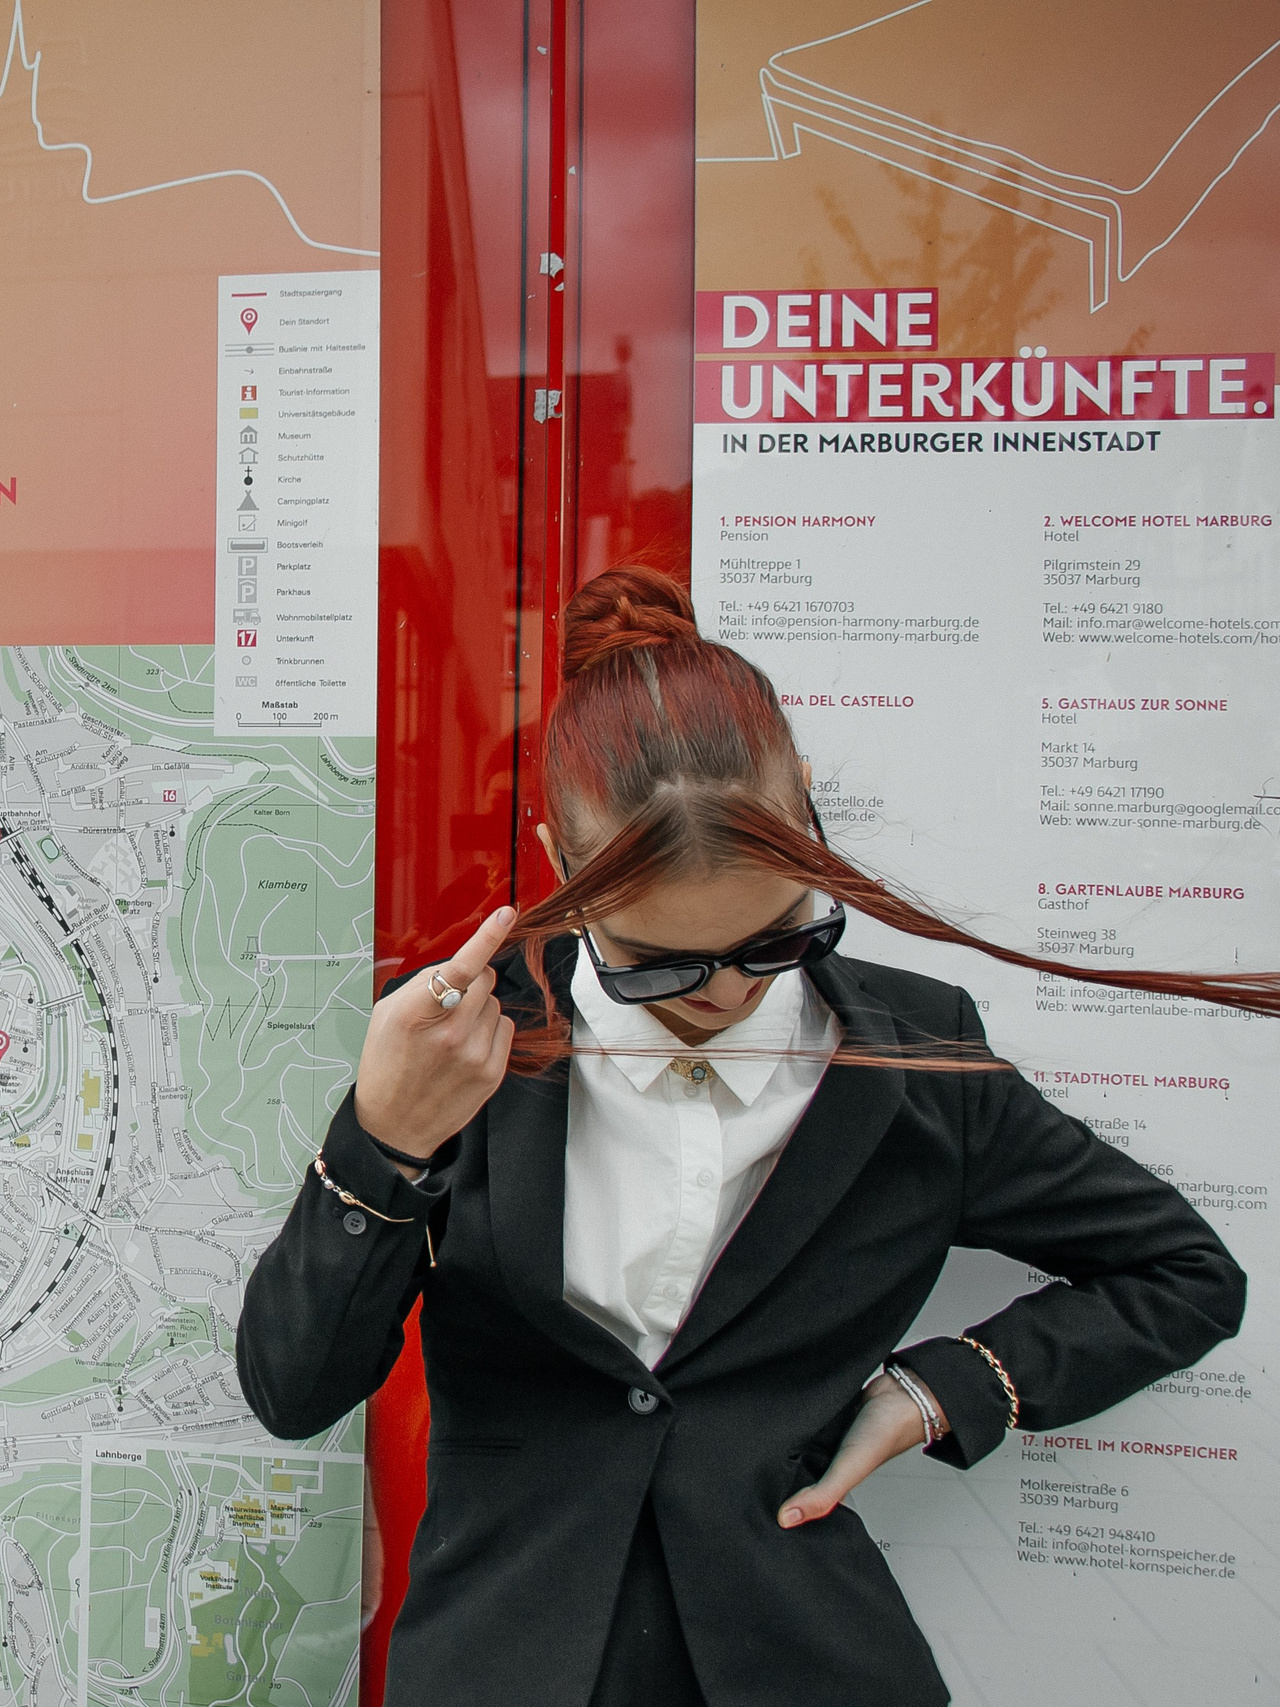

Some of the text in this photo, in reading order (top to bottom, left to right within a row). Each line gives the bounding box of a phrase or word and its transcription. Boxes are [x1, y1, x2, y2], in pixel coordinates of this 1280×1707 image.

[280, 289, 342, 297] Stadtspaziergang
[722, 293, 932, 348] DEINE
[722, 346, 1267, 419] UNTERKÜNFTE.
[279, 388, 350, 396] Tourist-Information
[278, 410, 355, 418] Universitätsgebäude
[723, 431, 1161, 453] IN DER MARBURGER INNENSTADT
[277, 497, 329, 506] Campingplatz
[277, 519, 307, 528] Minigolf
[720, 516, 875, 526] 1. PENSION HARMONY
[1044, 515, 1272, 526] 2. WELCOME HOTEL MARBURG
[721, 531, 768, 541] Pension
[1044, 531, 1079, 541] Hotel
[242, 558, 254, 574] P
[277, 563, 311, 571] Parkplatz
[720, 559, 801, 571] Mühltreppe 1
[1044, 560, 1140, 573] Pilgrimstein 29
[720, 573, 812, 586] 35037 Marburg
[1043, 574, 1140, 587] 35037 Marburg
[242, 588, 254, 601] P
[720, 601, 854, 612] Tel.: +49 6421 1670703
[1044, 603, 1163, 614] Tel.: +49 6421 9180
[276, 614, 352, 622] Wohnmobilstellplatz
[720, 616, 979, 630] Mail: info@pension-harmony-marburg.de
[1043, 618, 1072, 628] Mail:
[239, 631, 255, 645] 17
[719, 630, 979, 644] Web: www.pension-harmony-marburg.de
[1043, 632, 1280, 645] Web: www.welcome-hotels.com/ho
[810, 695, 835, 706] DEL
[841, 696, 914, 707] CASTELLO
[1042, 699, 1227, 711] 5. GASTHAUS ZUR SONNE
[1042, 713, 1076, 724] Hotel
[1042, 742, 1095, 753] Markt 14
[1041, 757, 1138, 771] 35037 Marburg
[164, 791, 175, 801] 16
[1041, 786, 1164, 798] Tel.: +49 6421 17190
[1040, 801, 1070, 811] Mail:
[1040, 815, 1261, 832] Web: www.zur-sonne-marburg.de
[258, 880, 307, 892] Klamberg
[1038, 884, 1244, 899] 8. GARTENLAUBE MARBURG
[1038, 899, 1089, 910] Gasthof
[1037, 928, 1116, 942] Steinweg 38
[1037, 942, 1134, 957] 35037 Marburg
[1037, 986, 1065, 997] Mail:
[1036, 1001, 1067, 1011] Web:
[267, 1022, 315, 1030] Spiegelslust
[1034, 1072, 1229, 1089] 11. STADTHOTEL MARBURG
[1134, 1120, 1146, 1130] 14
[56, 1168, 93, 1176] Anschluss
[1021, 1435, 1237, 1460] 17. HOTEL IM KORNSPEICHER
[96, 1450, 142, 1461] Lahnberge
[1021, 1450, 1057, 1463] Hotel
[1021, 1479, 1129, 1497] Molkereistraße 6
[1020, 1494, 1118, 1513] 35039 Marburg
[1019, 1522, 1155, 1542] Tel.: +49 6421 948410
[1018, 1536, 1235, 1564] Mail: info@hotel-kornspeicher.de
[1018, 1551, 1235, 1578] Web: www.hotel-kornspeicher.de
